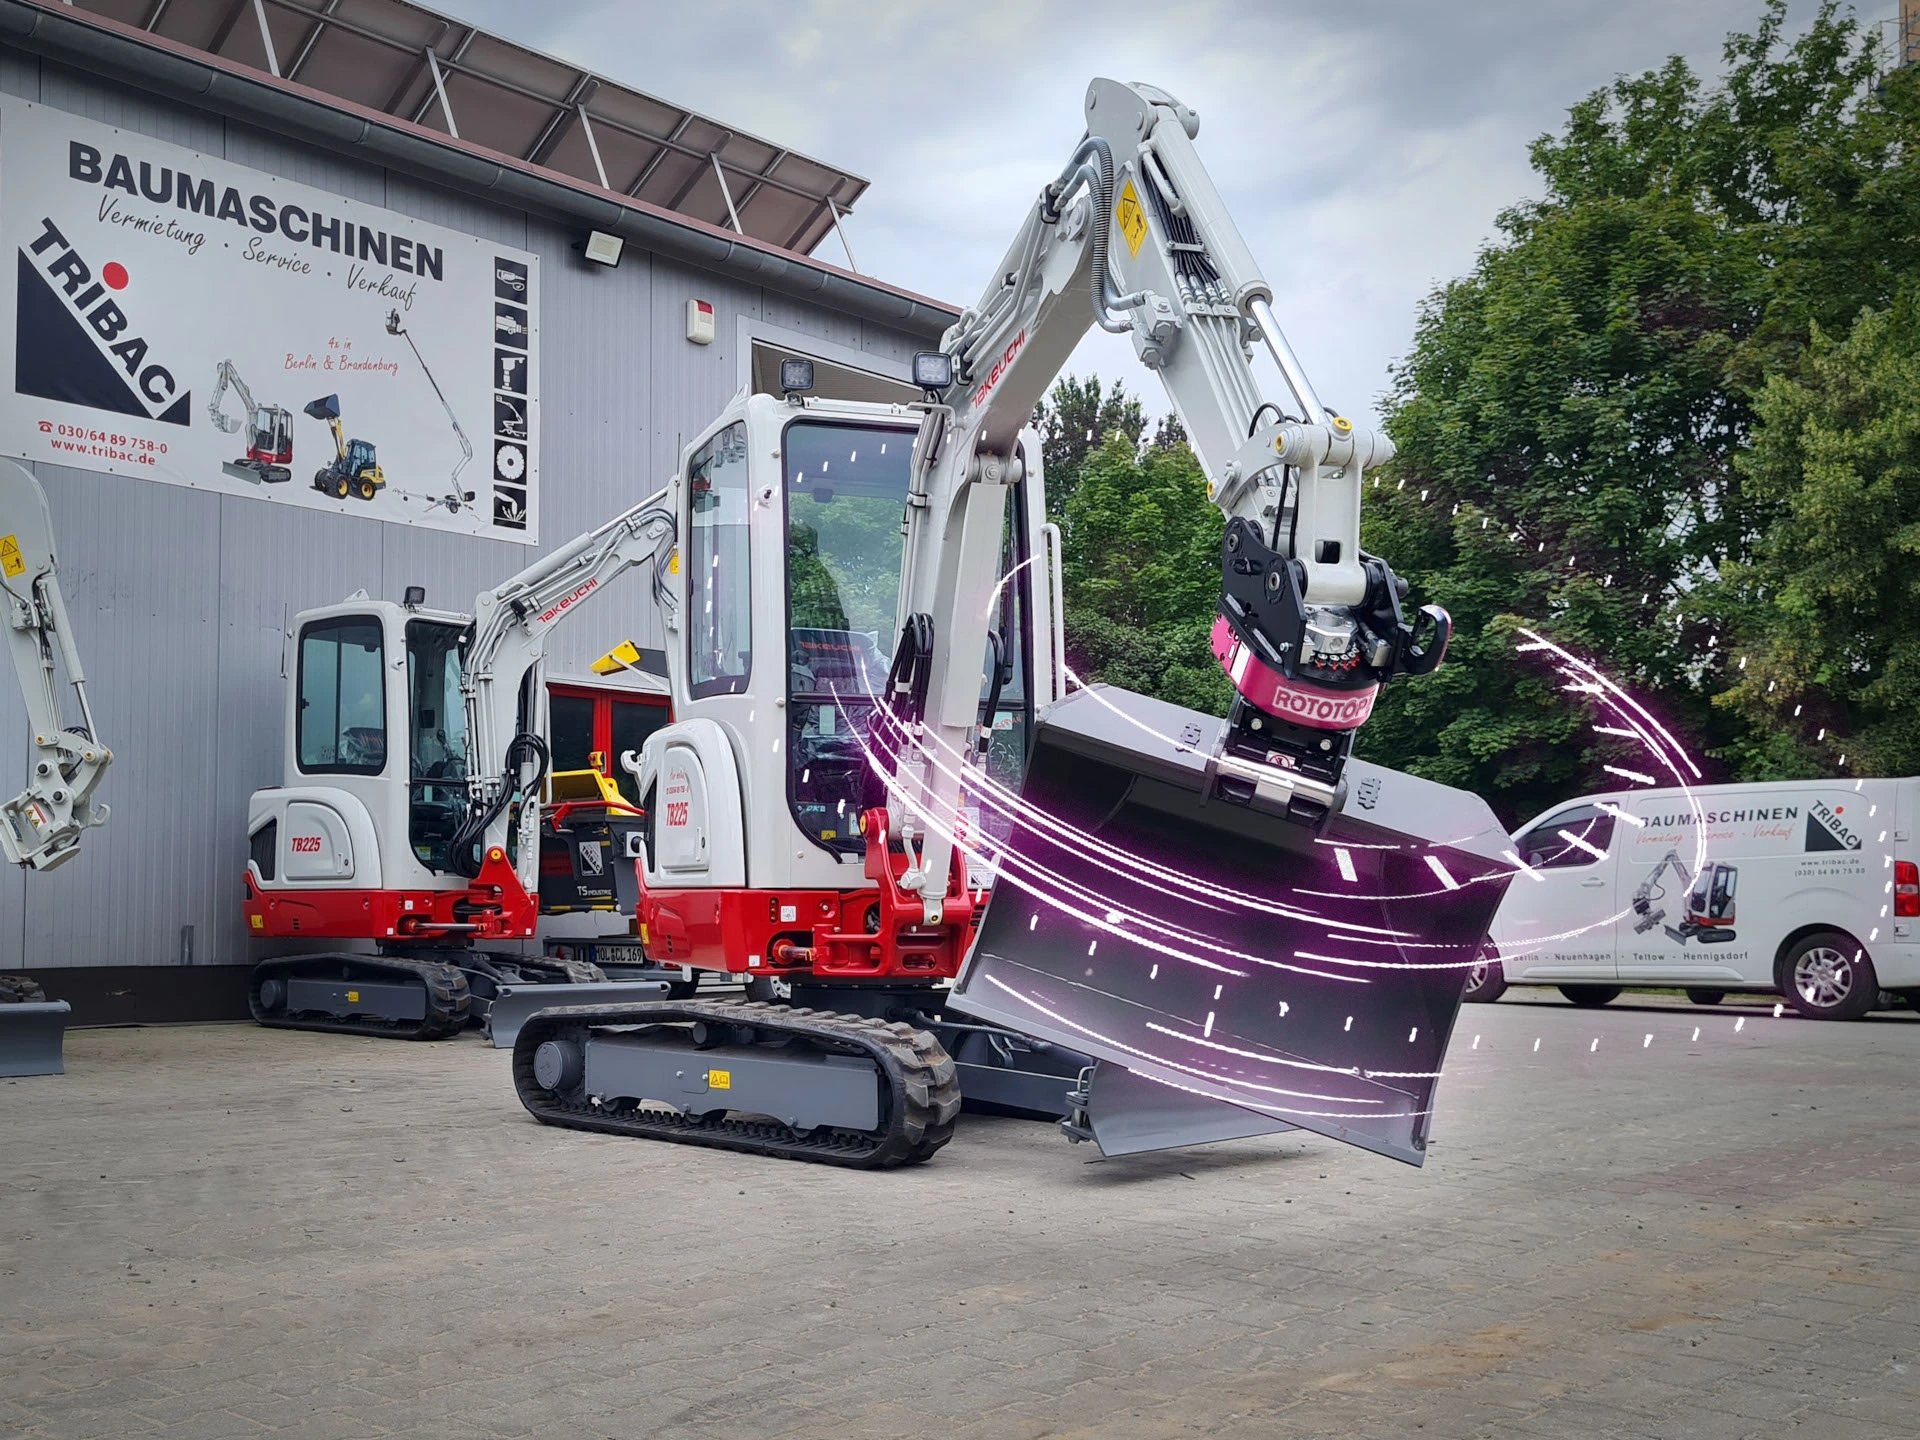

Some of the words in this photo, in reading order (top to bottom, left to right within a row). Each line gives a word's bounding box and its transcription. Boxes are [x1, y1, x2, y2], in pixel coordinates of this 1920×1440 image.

[69, 139, 444, 282] BAUMASCHINEN
[98, 193, 206, 256] Vermietung
[242, 236, 312, 275] Service
[347, 263, 417, 312] Verkauf
[29, 216, 176, 404] TRIBAC
[284, 353, 317, 370] Berlin
[323, 355, 334, 370] &
[339, 354, 399, 377] Brandenburg
[972, 328, 1025, 409] TAKEUCHI
[58, 424, 106, 443] 030/64
[110, 433, 127, 446] 89
[130, 437, 168, 454] 758-0
[51, 439, 156, 466] www.tribac.de
[536, 578, 598, 623] TAKEUCHI
[666, 802, 689, 826] TB225
[1641, 806, 1798, 828] BAUMASCHINEN
[1812, 799, 1858, 847] TRIBAC
[291, 836, 322, 852] TB225
[582, 846, 600, 871] TRIBAC
[577, 886, 588, 896] TS
[627, 948, 642, 961] 169
[1555, 953, 1612, 962] Neuenhagen
[1684, 951, 1748, 962] Hennigsdorf
